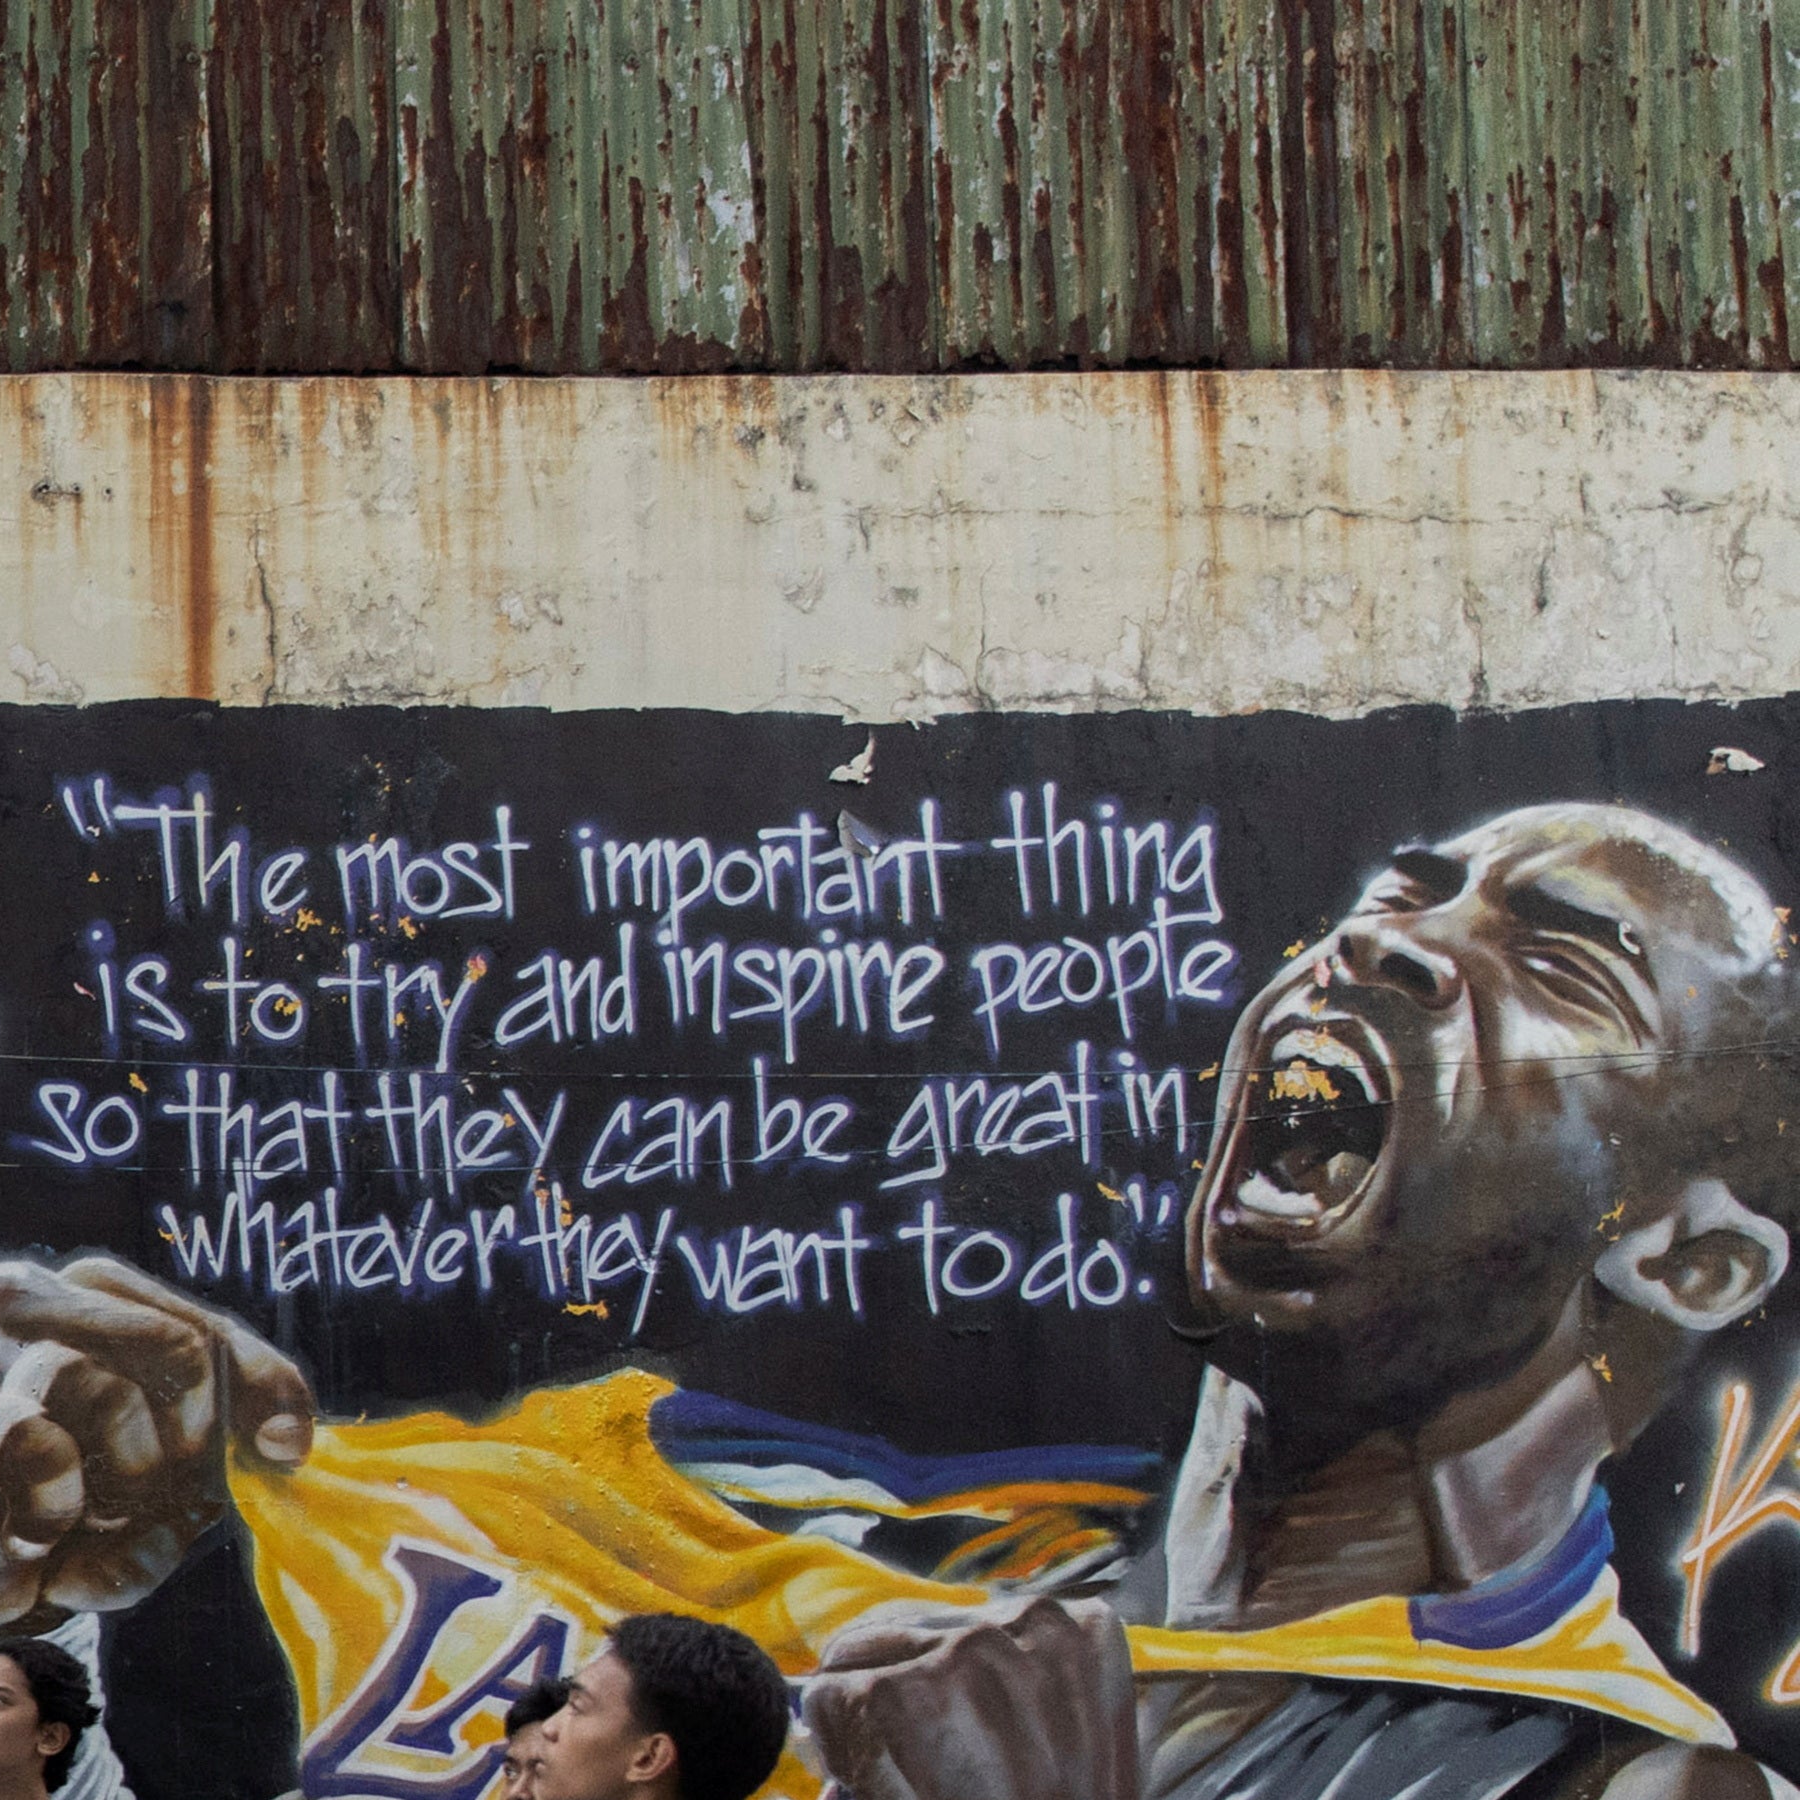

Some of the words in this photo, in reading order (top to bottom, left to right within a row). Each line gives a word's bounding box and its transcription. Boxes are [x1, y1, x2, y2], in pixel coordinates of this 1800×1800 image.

[336, 805, 530, 919] most
[578, 799, 962, 944] important
[992, 782, 1222, 924] thing
[91, 929, 186, 1041] is
[203, 937, 302, 1046] to
[317, 943, 486, 1074] try
[495, 922, 636, 1046] and
[656, 930, 945, 1064] inspire
[971, 898, 1234, 1052] people
[31, 1084, 139, 1163] so
[163, 1068, 351, 1190] that
[366, 1071, 564, 1196] they
[583, 1098, 733, 1189] can
[753, 1057, 850, 1163] be
[879, 1040, 1099, 1190] great
[1117, 1052, 1186, 1153] in
[161, 1160, 515, 1293] whatever
[519, 1182, 672, 1336] they
[677, 1206, 869, 1313] want
[899, 1200, 1012, 1315] to
